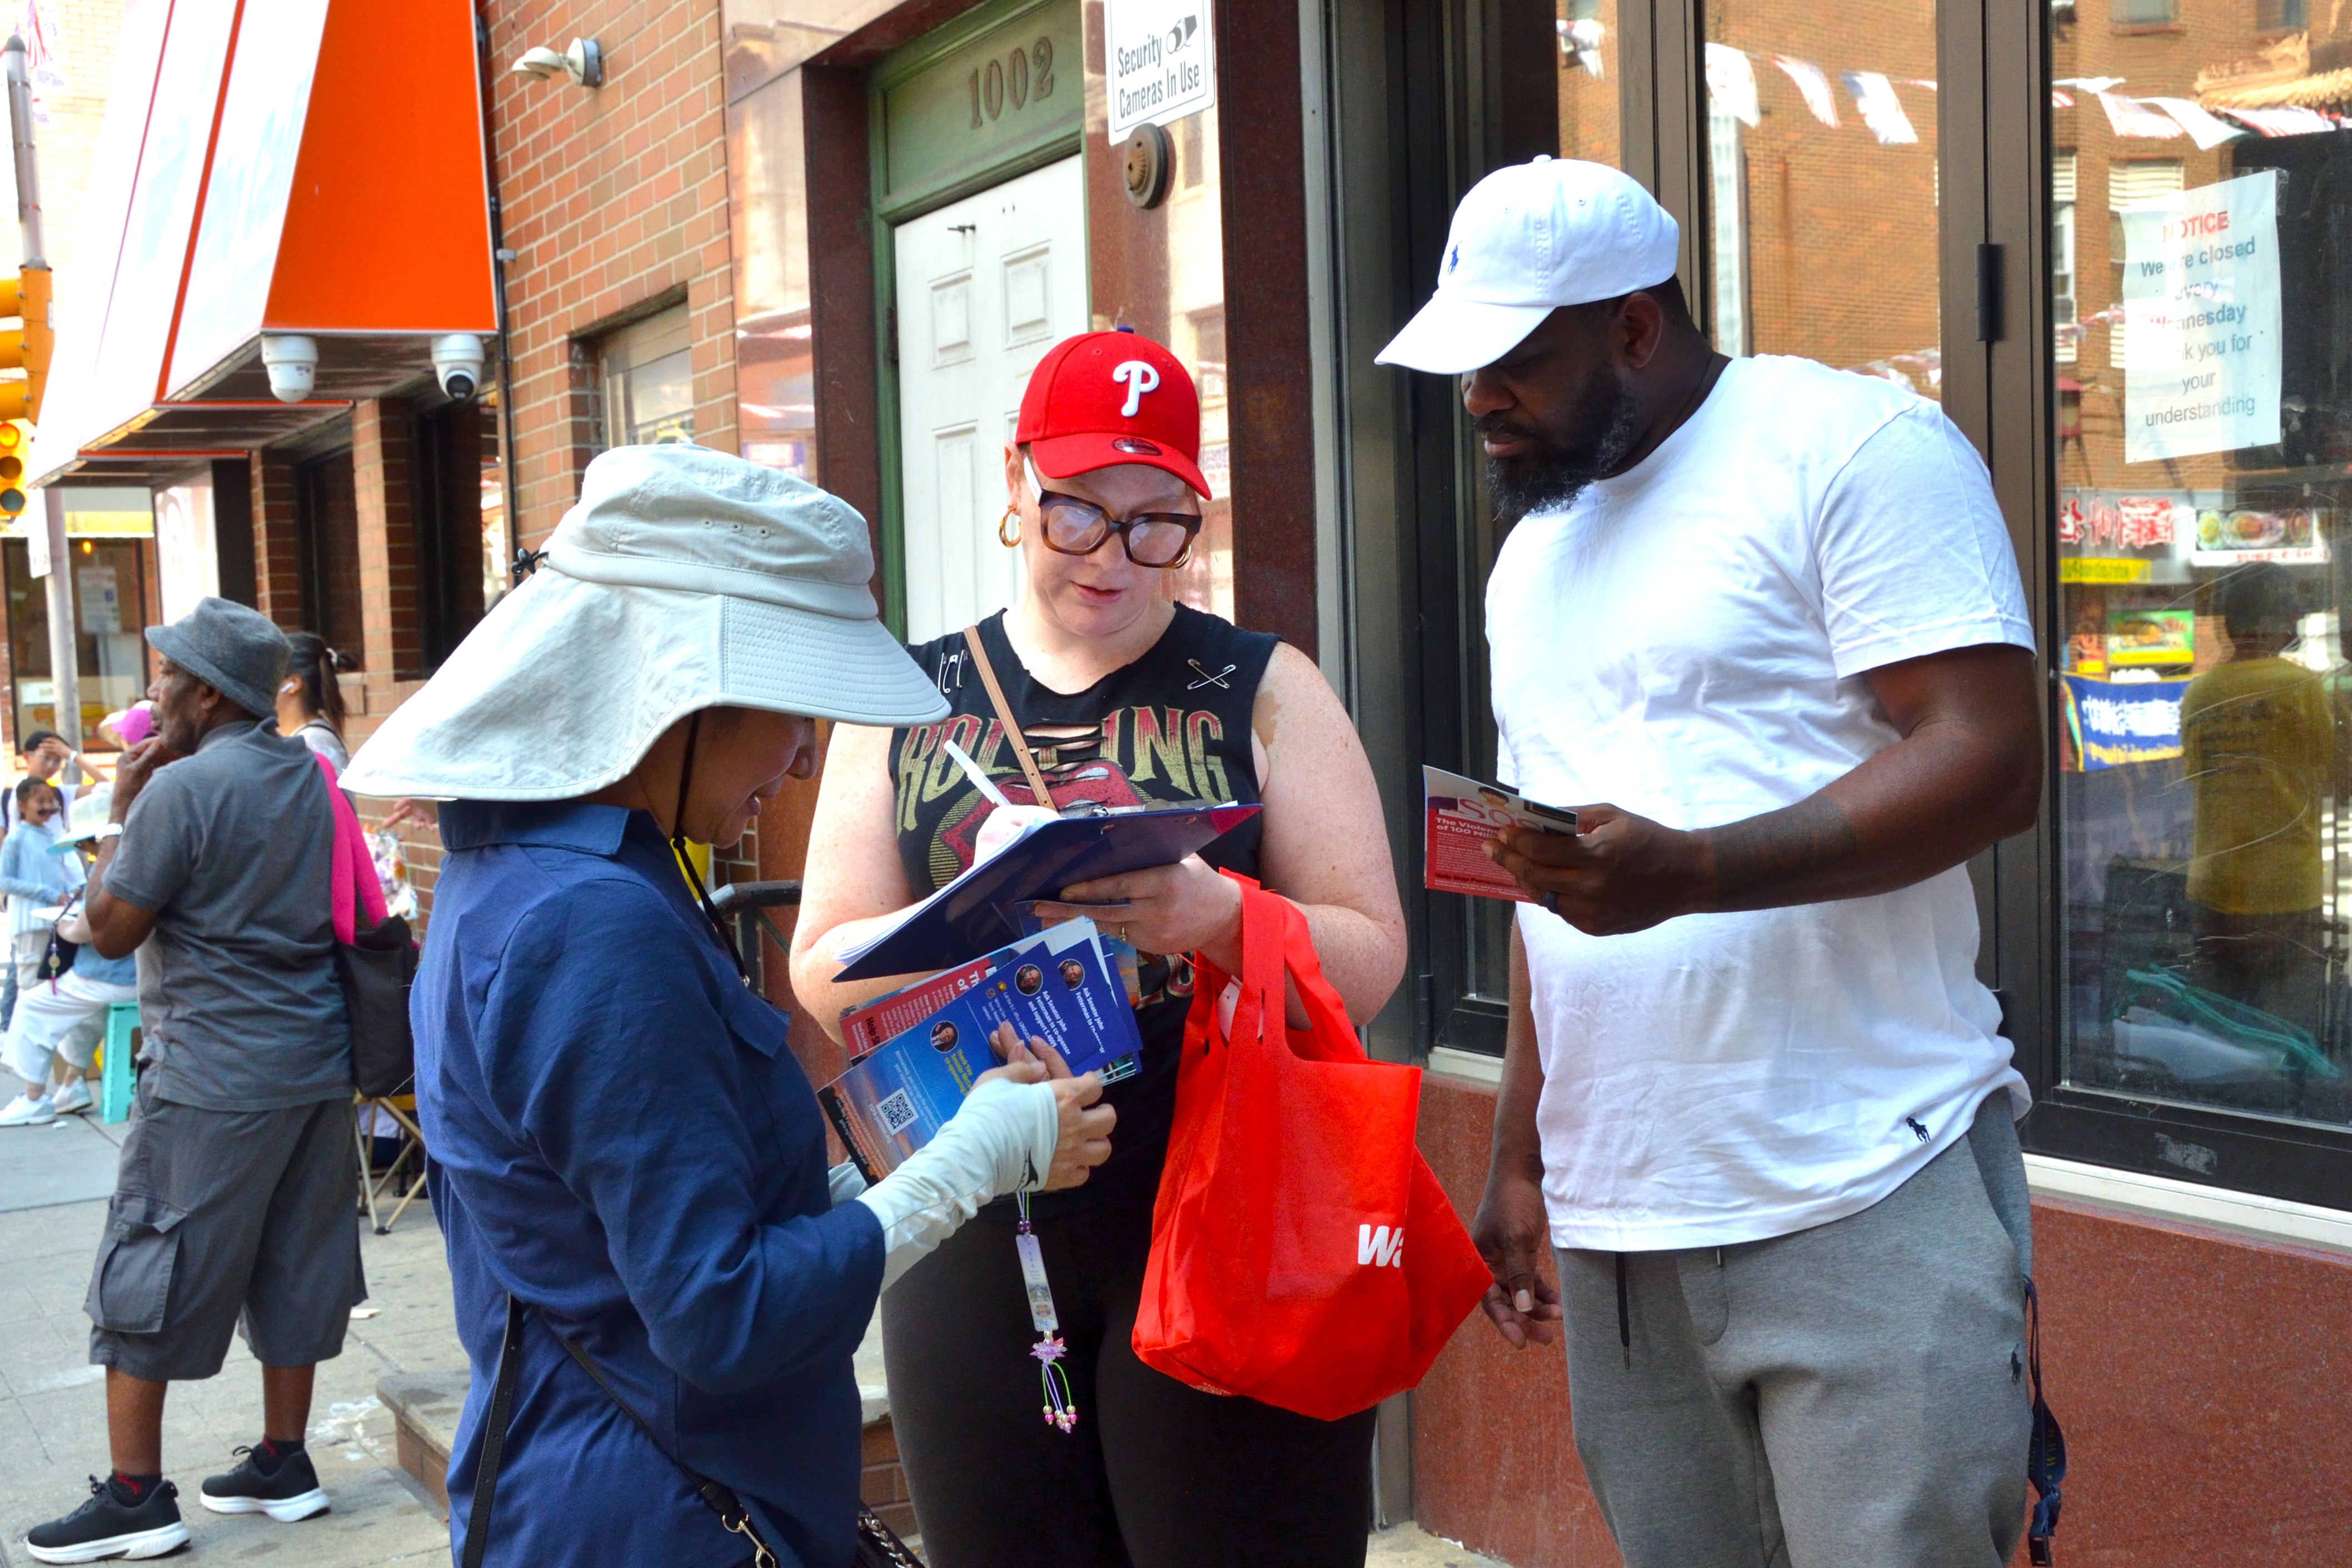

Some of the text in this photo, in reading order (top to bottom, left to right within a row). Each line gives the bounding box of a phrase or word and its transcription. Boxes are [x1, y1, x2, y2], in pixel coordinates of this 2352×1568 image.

[1118, 33, 1162, 78] Security
[968, 36, 1054, 129] 1002
[1119, 61, 1199, 119] Cameras In Use
[2140, 259, 2164, 277] We
[2199, 235, 2255, 265] closed
[2198, 340, 2226, 362] you
[2231, 333, 2253, 352] for
[1113, 360, 1160, 417] P
[2182, 372, 2216, 396] your
[2145, 396, 2255, 427] understanding
[897, 705, 1232, 838] ROLING
[1436, 817, 1456, 826] The
[947, 983, 956, 1000] Fearfu
[956, 977, 969, 992] of
[967, 970, 981, 987] Th
[1041, 990, 1068, 1033] Ask Senator John
[1074, 991, 1092, 1020] Fetterman
[1082, 986, 1105, 1031] Ask Senator John
[864, 1016, 881, 1046] Help St
[1027, 1000, 1057, 1048] and support S.4009
[1034, 996, 1053, 1023] Fetterman
[1051, 1027, 1072, 1056] co-sponsor
[950, 1053, 964, 1073] Senator
[955, 1048, 974, 1076] Thank You
